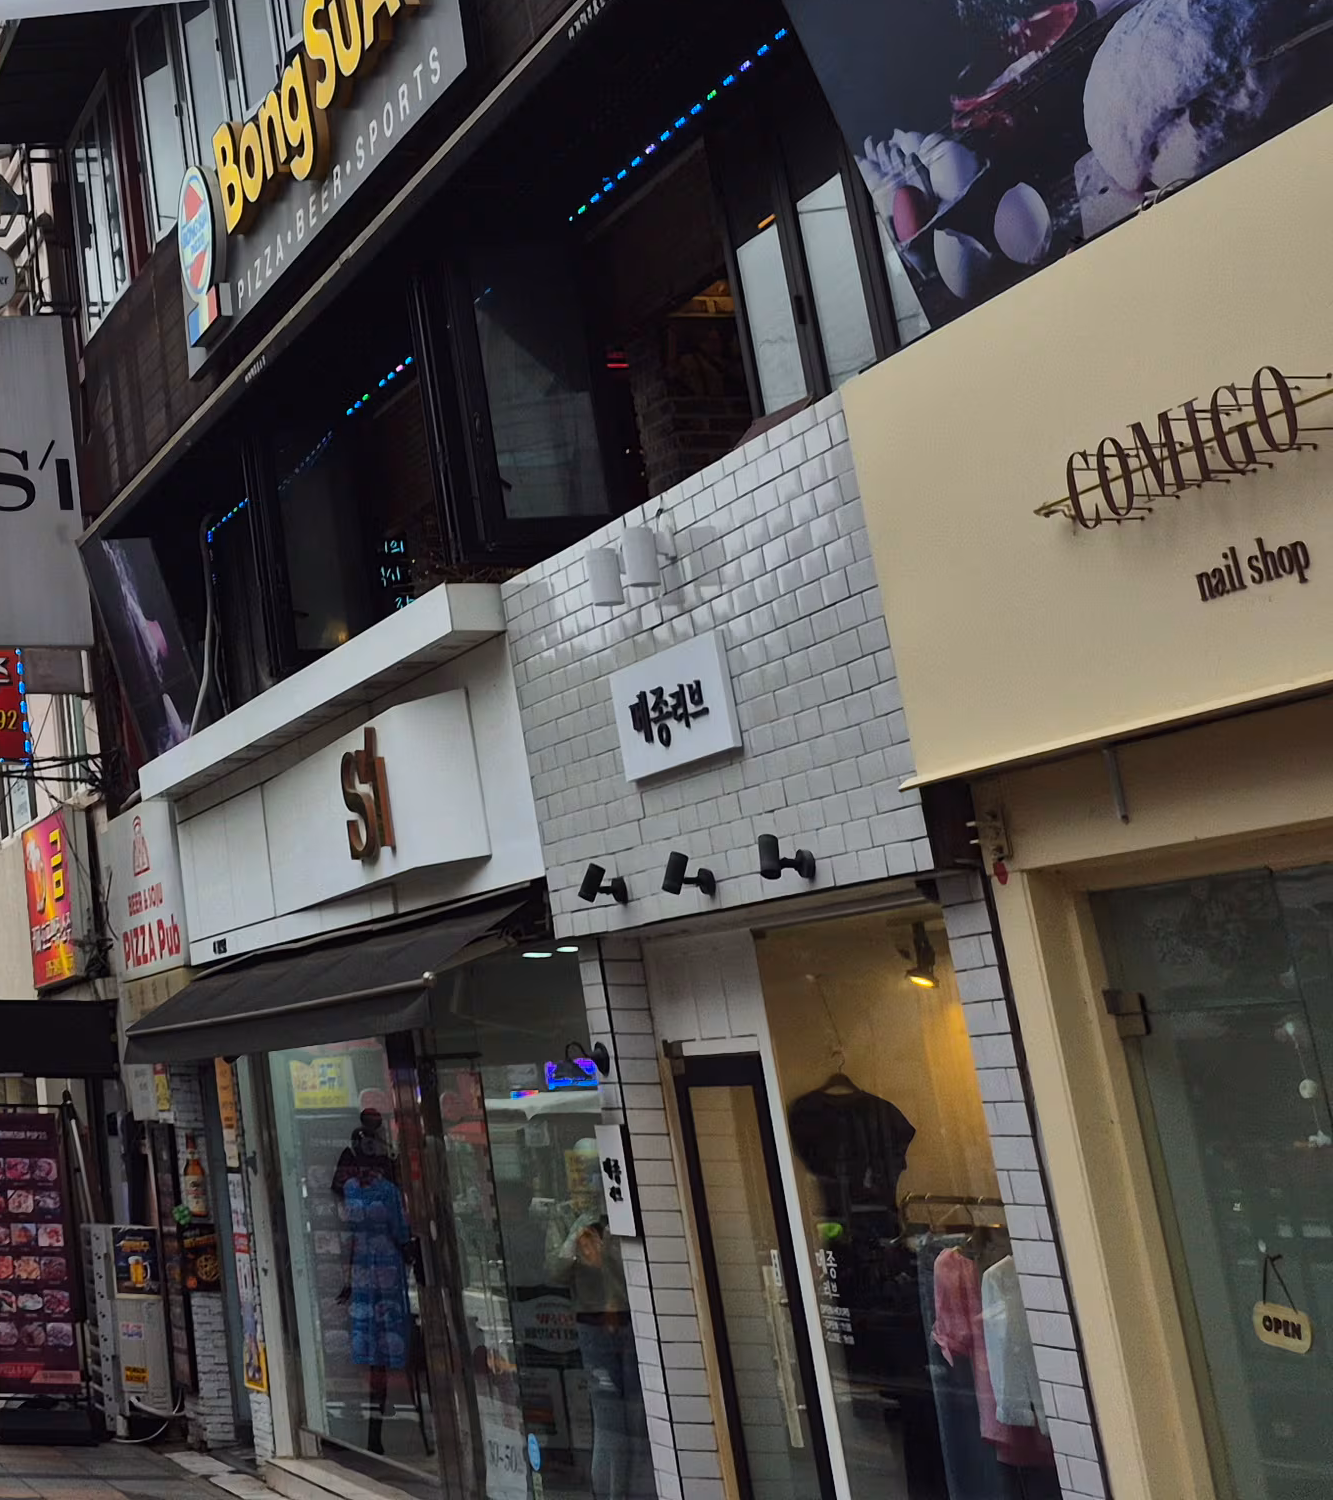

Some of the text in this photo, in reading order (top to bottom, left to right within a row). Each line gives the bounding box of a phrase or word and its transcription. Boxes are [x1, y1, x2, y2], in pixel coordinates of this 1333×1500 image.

[1195, 537, 1312, 603] nail shop
[122, 923, 157, 971] PIZZA
[1261, 1313, 1303, 1343] OPEN
